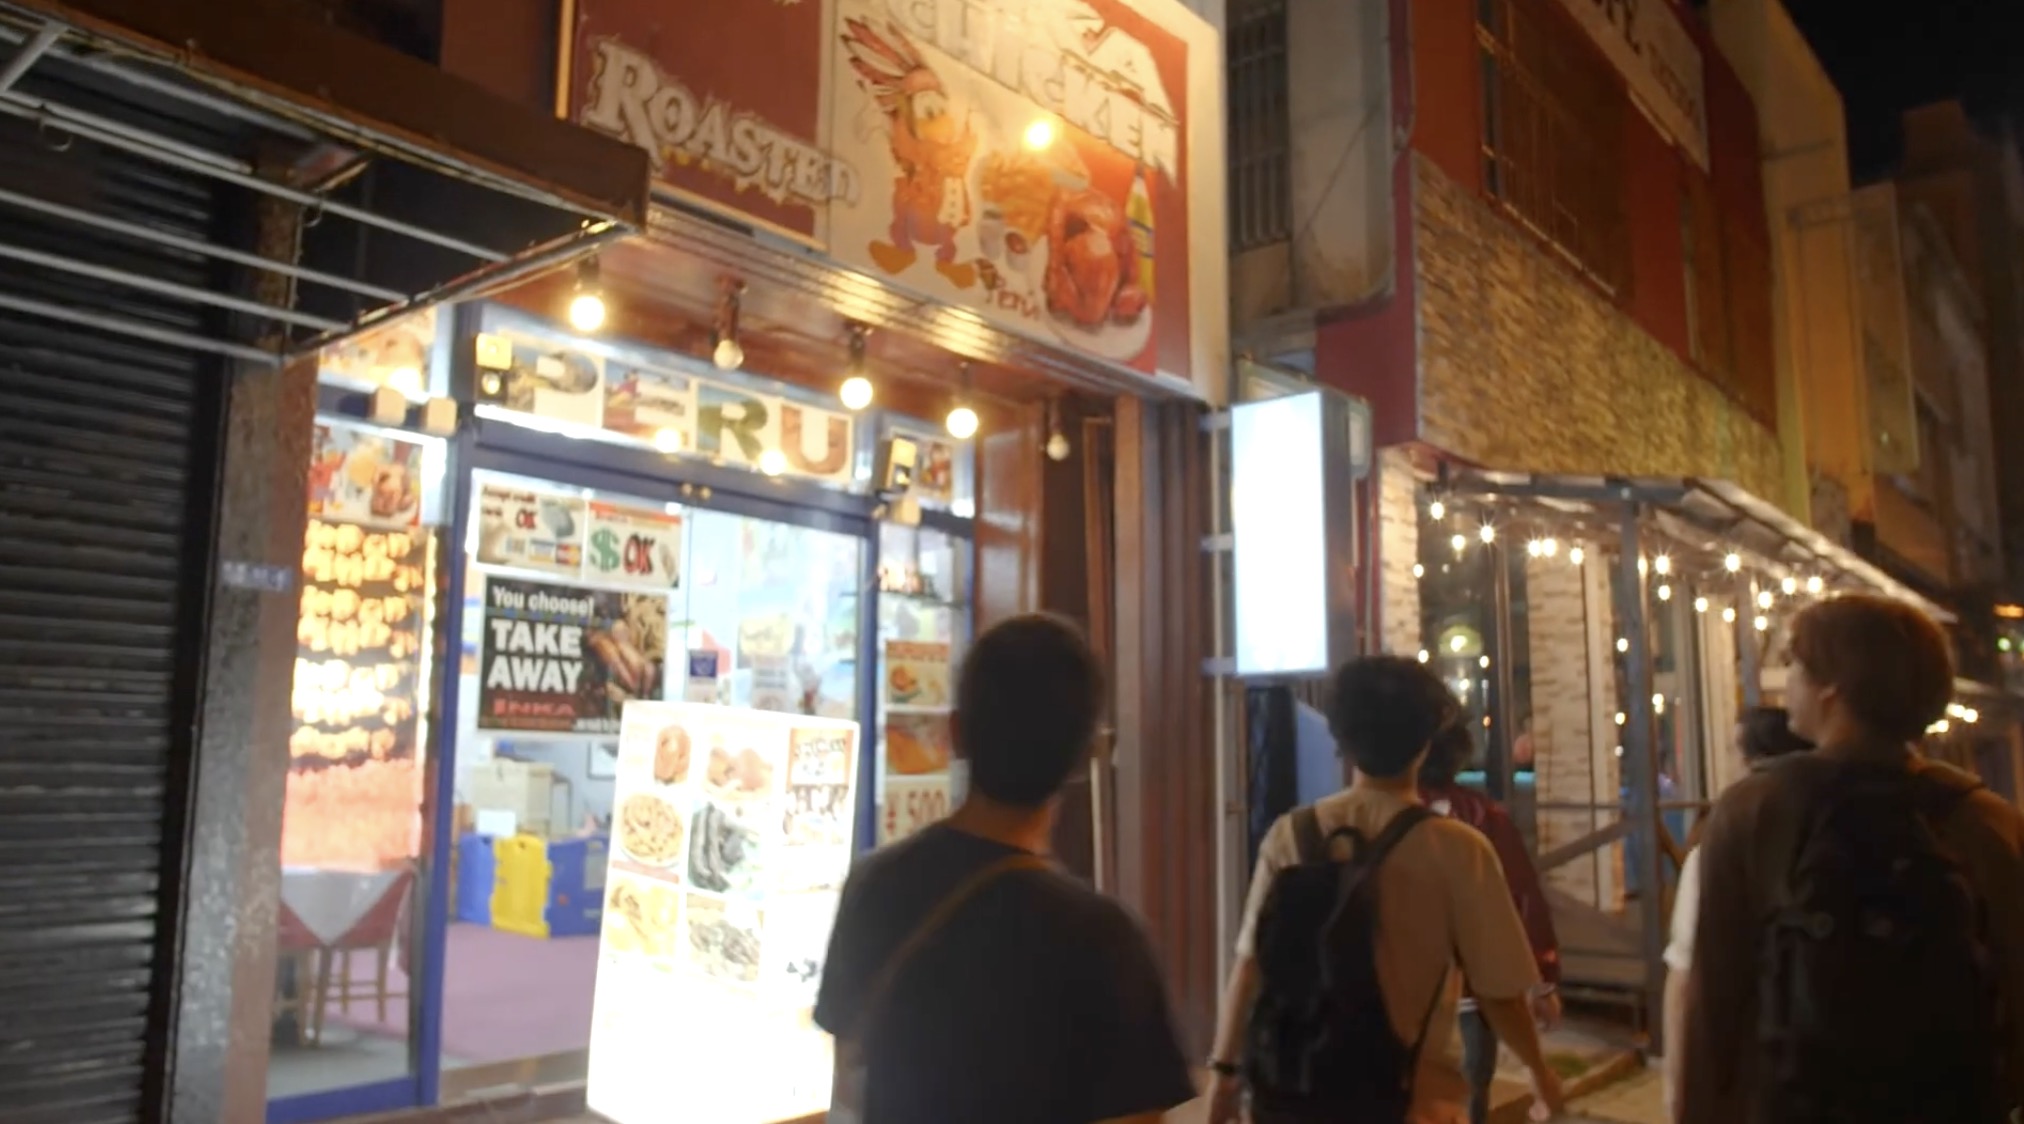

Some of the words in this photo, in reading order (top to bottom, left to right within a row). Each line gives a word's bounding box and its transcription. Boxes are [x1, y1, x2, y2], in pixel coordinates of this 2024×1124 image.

[581, 38, 858, 206] ROASTED
[492, 586, 525, 608] You
[528, 591, 594, 613] choose!
[491, 618, 583, 657] TAKE
[487, 655, 583, 693] AWAY
